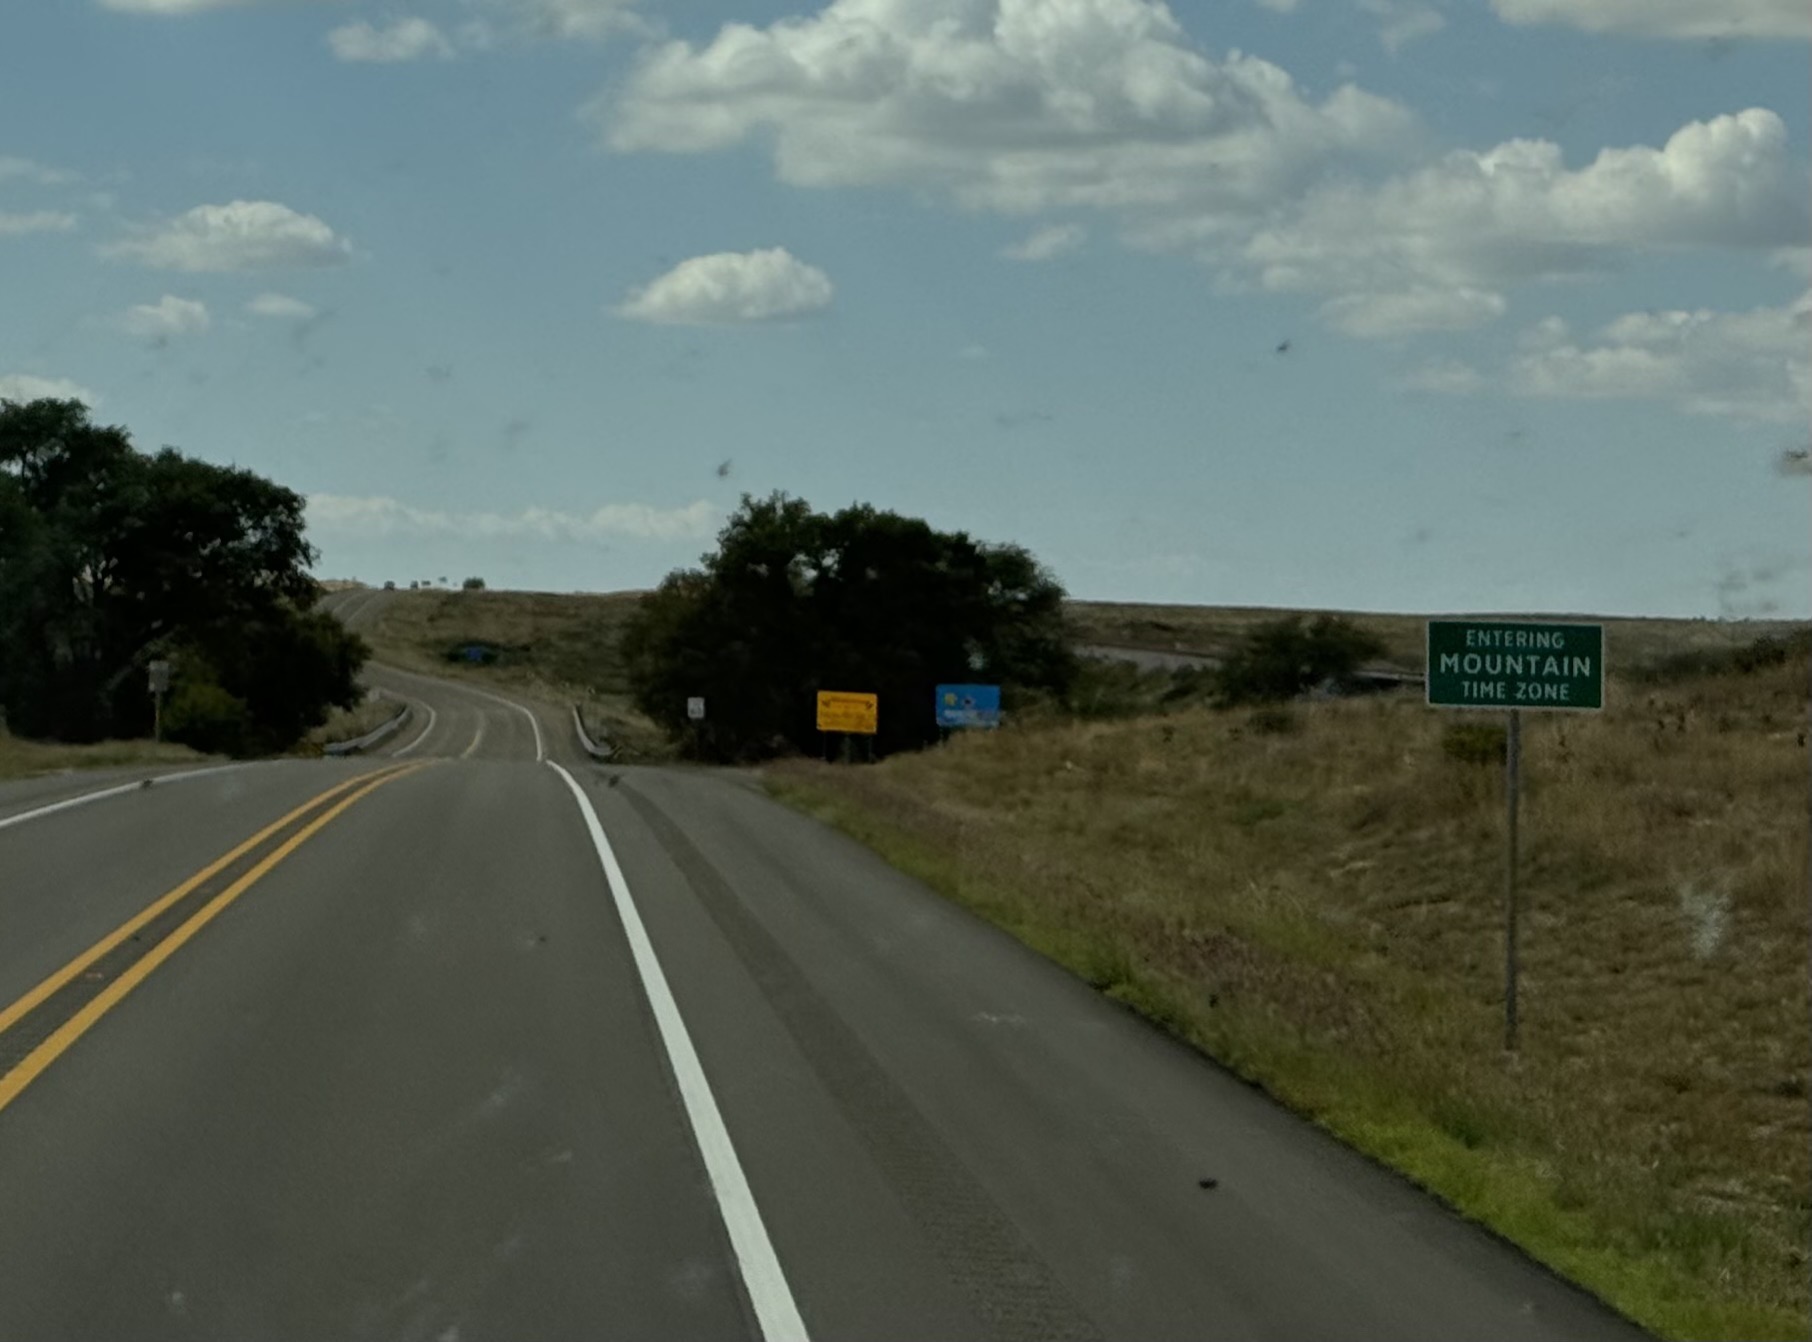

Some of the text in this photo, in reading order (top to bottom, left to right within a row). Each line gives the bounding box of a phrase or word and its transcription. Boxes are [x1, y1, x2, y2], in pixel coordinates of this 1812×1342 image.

[1466, 629, 1565, 649] ENTERING
[1440, 653, 1591, 677] MOUNTAIN
[1462, 681, 1570, 700] TIME ZONE
